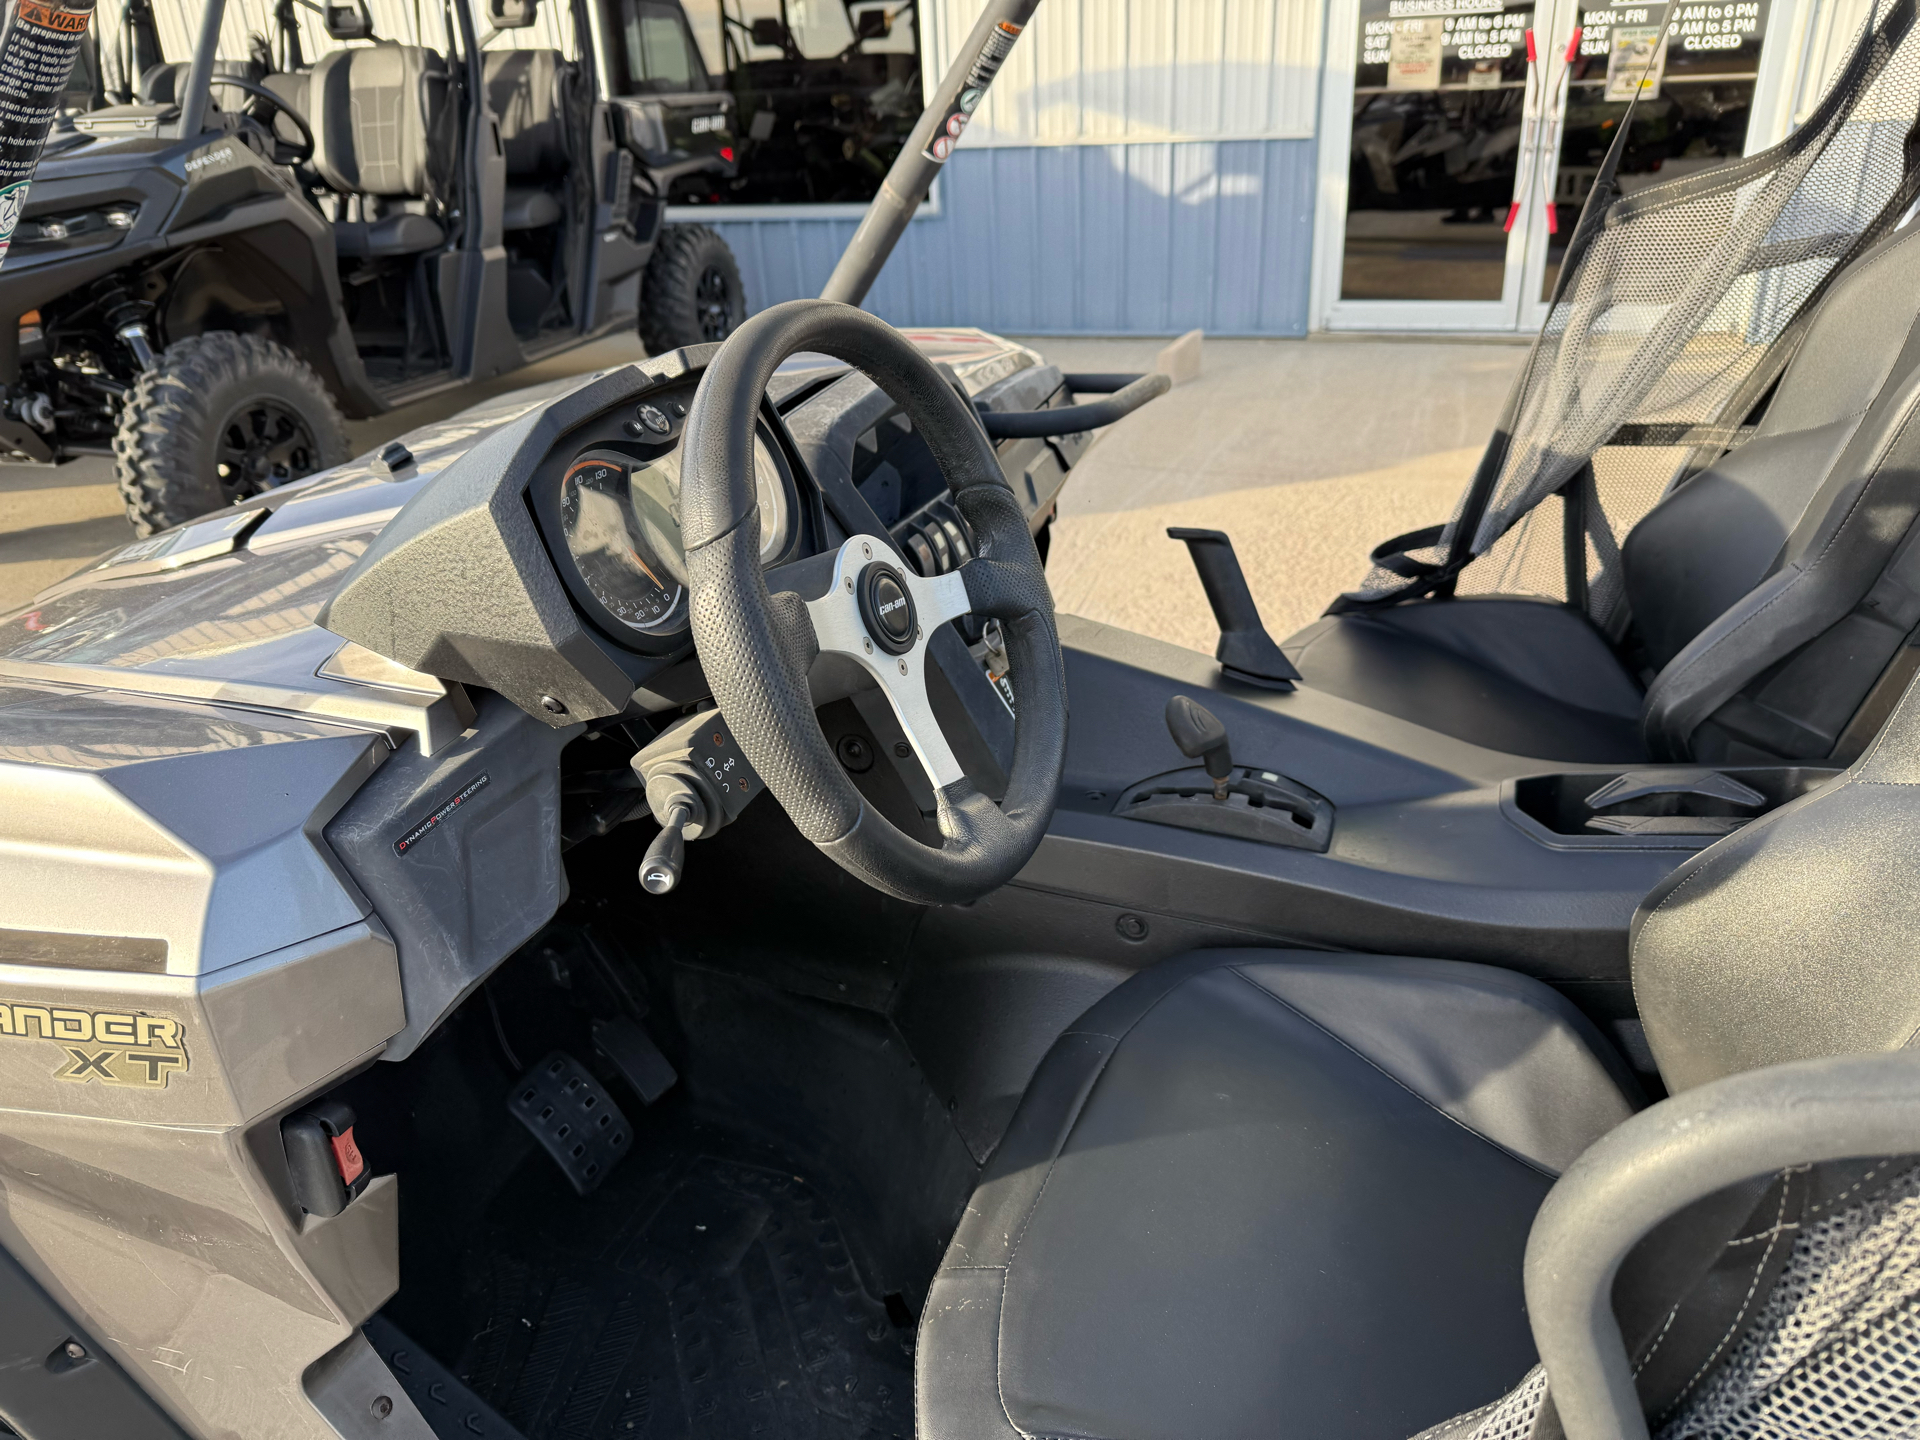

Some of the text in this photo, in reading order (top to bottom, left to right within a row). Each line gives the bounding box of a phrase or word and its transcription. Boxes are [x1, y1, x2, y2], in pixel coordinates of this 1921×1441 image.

[1365, 20, 1395, 35] MON
[1403, 20, 1425, 33] FRI
[1445, 18, 1455, 31] 9
[1456, 16, 1477, 30] AM
[1478, 16, 1492, 29] to
[1493, 15, 1503, 29] 6
[1504, 13, 1526, 28] PM
[1584, 9, 1617, 25] MON
[1625, 8, 1648, 23] FRI
[1683, 6, 1706, 20] AM
[1707, 5, 1722, 19] to
[1724, 4, 1734, 18] 6
[1736, 3, 1759, 17] PM
[16, 18, 31, 31] Be
[31, 26, 70, 41] prepared
[1364, 35, 1389, 50] SAT
[1440, 31, 1451, 46] 9
[1451, 30, 1473, 45] AM
[1474, 30, 1488, 44] to
[1489, 29, 1499, 43] 5
[1500, 28, 1522, 42] PM
[1582, 25, 1608, 40] SAT
[1668, 22, 1679, 36] 9
[1680, 20, 1703, 35] AM
[1705, 20, 1720, 34] to
[1721, 19, 1732, 33] 5
[1733, 18, 1757, 32] PM
[11, 32, 20, 43] If
[20, 37, 36, 49] the
[37, 44, 64, 55] vehicle
[1363, 50, 1391, 64] SUN
[1458, 43, 1512, 59] CLOSED
[1580, 33, 1742, 55] SUN CLOSED
[4, 52, 26, 68] legs,
[28, 62, 38, 71] or
[8, 44, 19, 53] of
[19, 49, 40, 60] your
[41, 54, 60, 65] body
[1, 63, 36, 80] cockpit
[36, 75, 50, 83] can
[0, 83, 29, 99] ehicle.
[23, 82, 33, 90] or
[33, 84, 53, 92] other
[0, 99, 20, 112] sten
[21, 106, 35, 115] net
[35, 107, 48, 115] and
[5, 111, 29, 123] avoid
[8, 136, 25, 147] hold
[184, 147, 233, 172] DEFENDER
[595, 469, 607, 480] 130
[663, 593, 670, 602] 0
[617, 606, 627, 617] 30
[635, 609, 646, 620] 20
[652, 605, 661, 615] 10
[61, 1046, 183, 1084] XT
